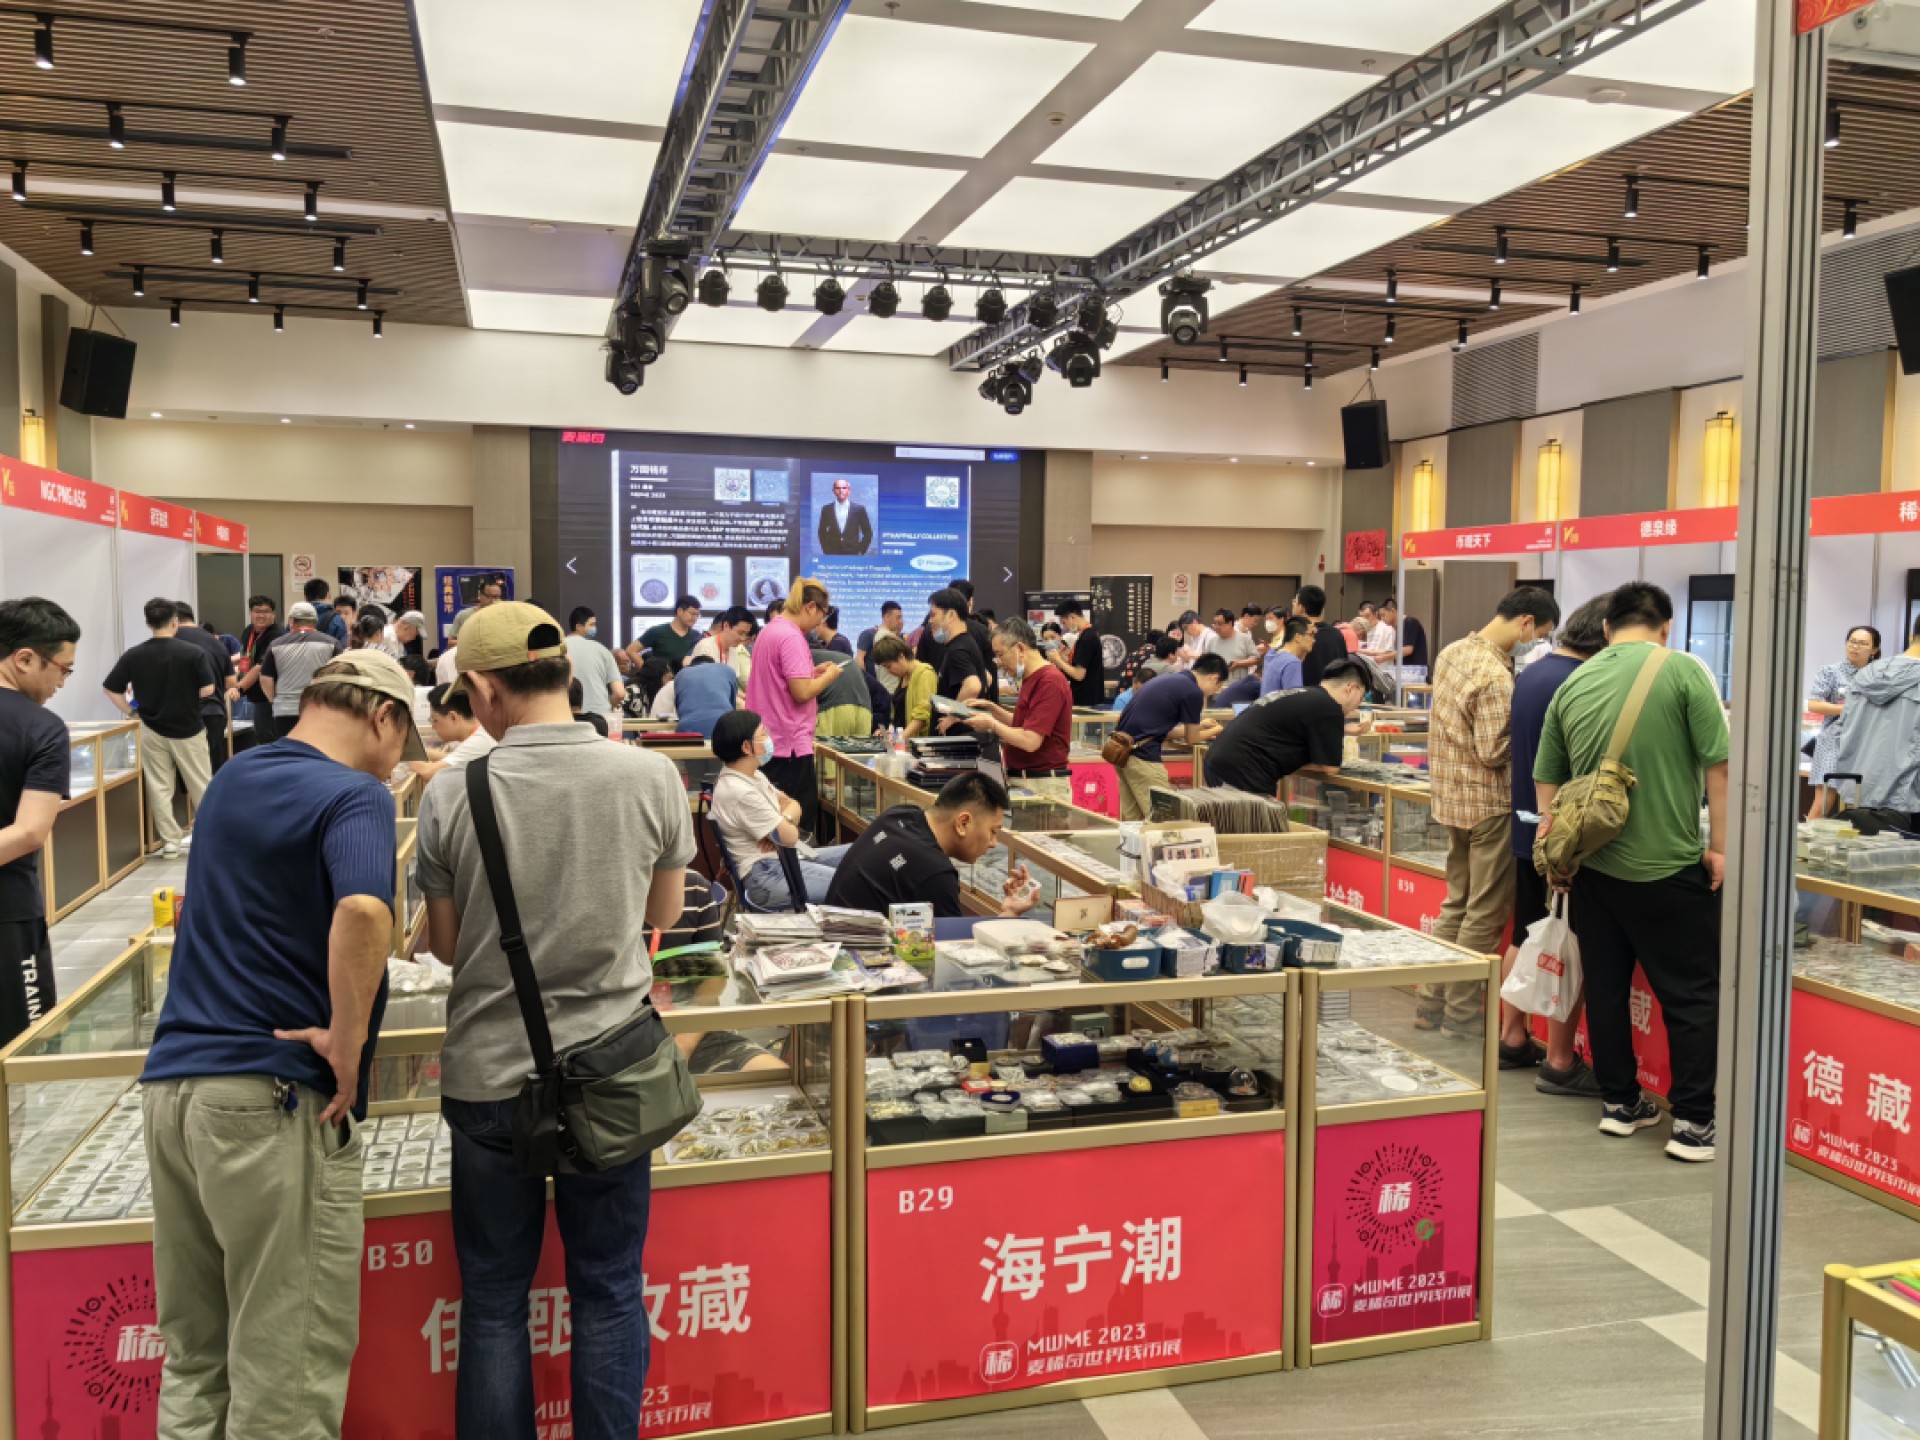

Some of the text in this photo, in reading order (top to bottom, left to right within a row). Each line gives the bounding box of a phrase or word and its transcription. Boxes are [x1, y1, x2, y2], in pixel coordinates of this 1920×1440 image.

[21, 954, 42, 1026] TRAIN
[1819, 1129, 1898, 1172] MWME 2023
[899, 1186, 955, 1214] B29
[367, 1239, 434, 1271] B30
[979, 1216, 1182, 1304] 海宁潮
[1352, 1270, 1446, 1297] MWME 2023
[1027, 1322, 1147, 1356] MWME 2023
